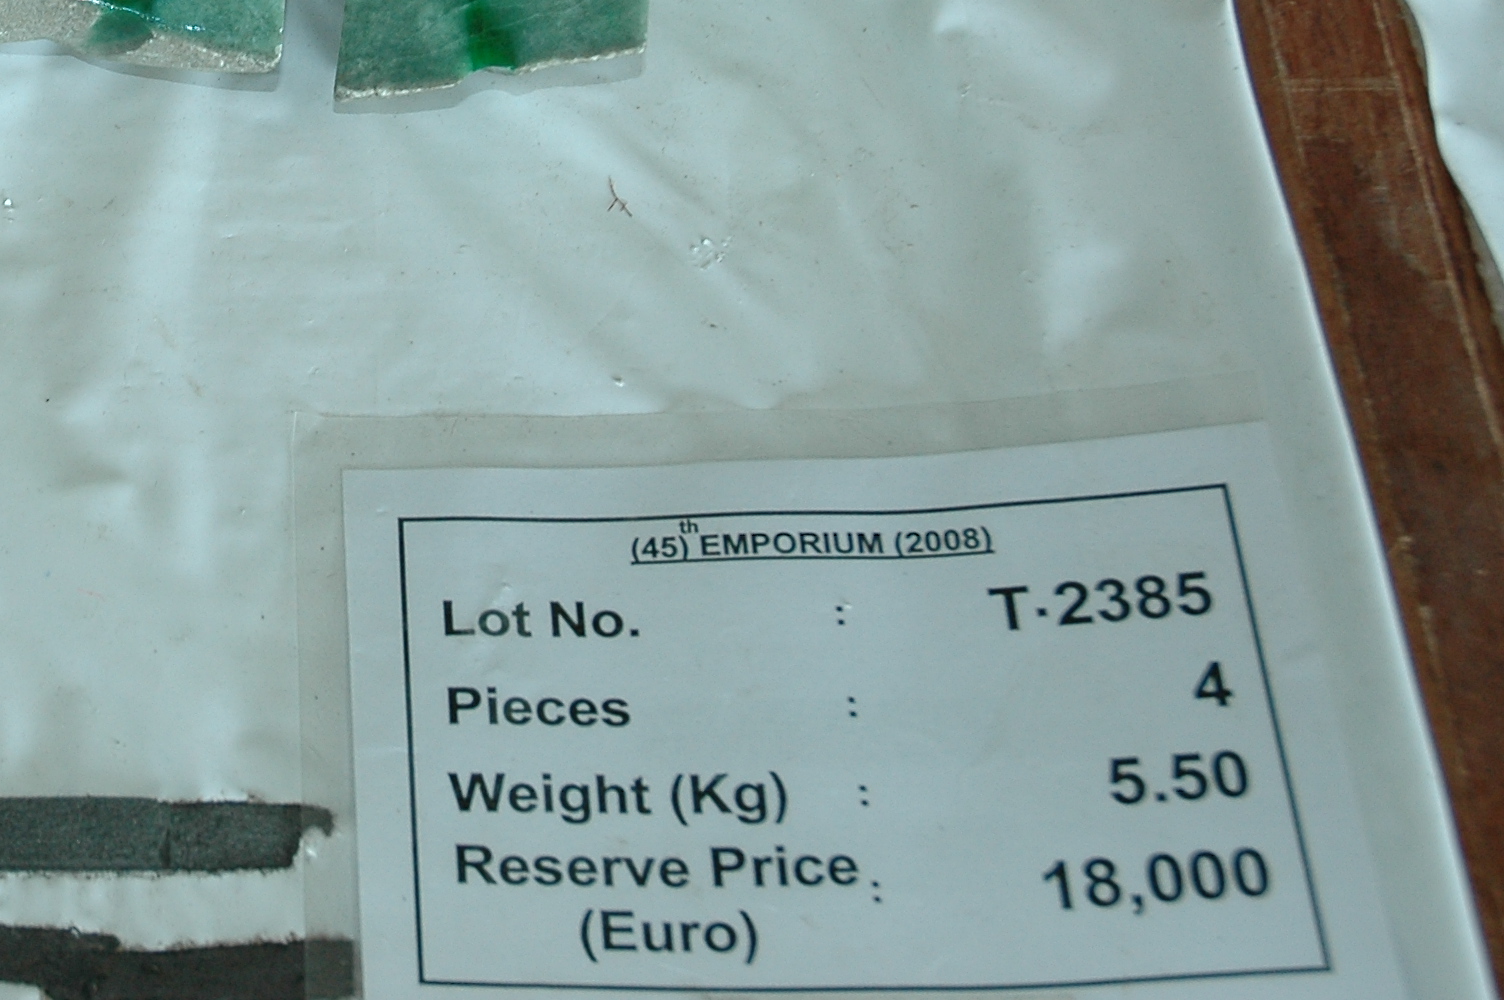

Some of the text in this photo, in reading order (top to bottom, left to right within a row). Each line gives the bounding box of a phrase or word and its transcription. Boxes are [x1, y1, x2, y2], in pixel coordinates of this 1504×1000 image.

[700, 532, 884, 557] EMPORIUM
[894, 526, 994, 558] (2008)
[442, 599, 533, 638] Lot
[549, 600, 640, 639] No.
[446, 686, 632, 728] Pieces
[1192, 660, 1235, 708] 4
[447, 771, 653, 826] Weight
[669, 770, 789, 827] (Kg)
[1108, 749, 1251, 806] 5.50
[455, 843, 691, 890] Reserve
[709, 844, 860, 889] Price
[1042, 846, 1272, 916] 18,000
[579, 908, 759, 966] (Euro)
